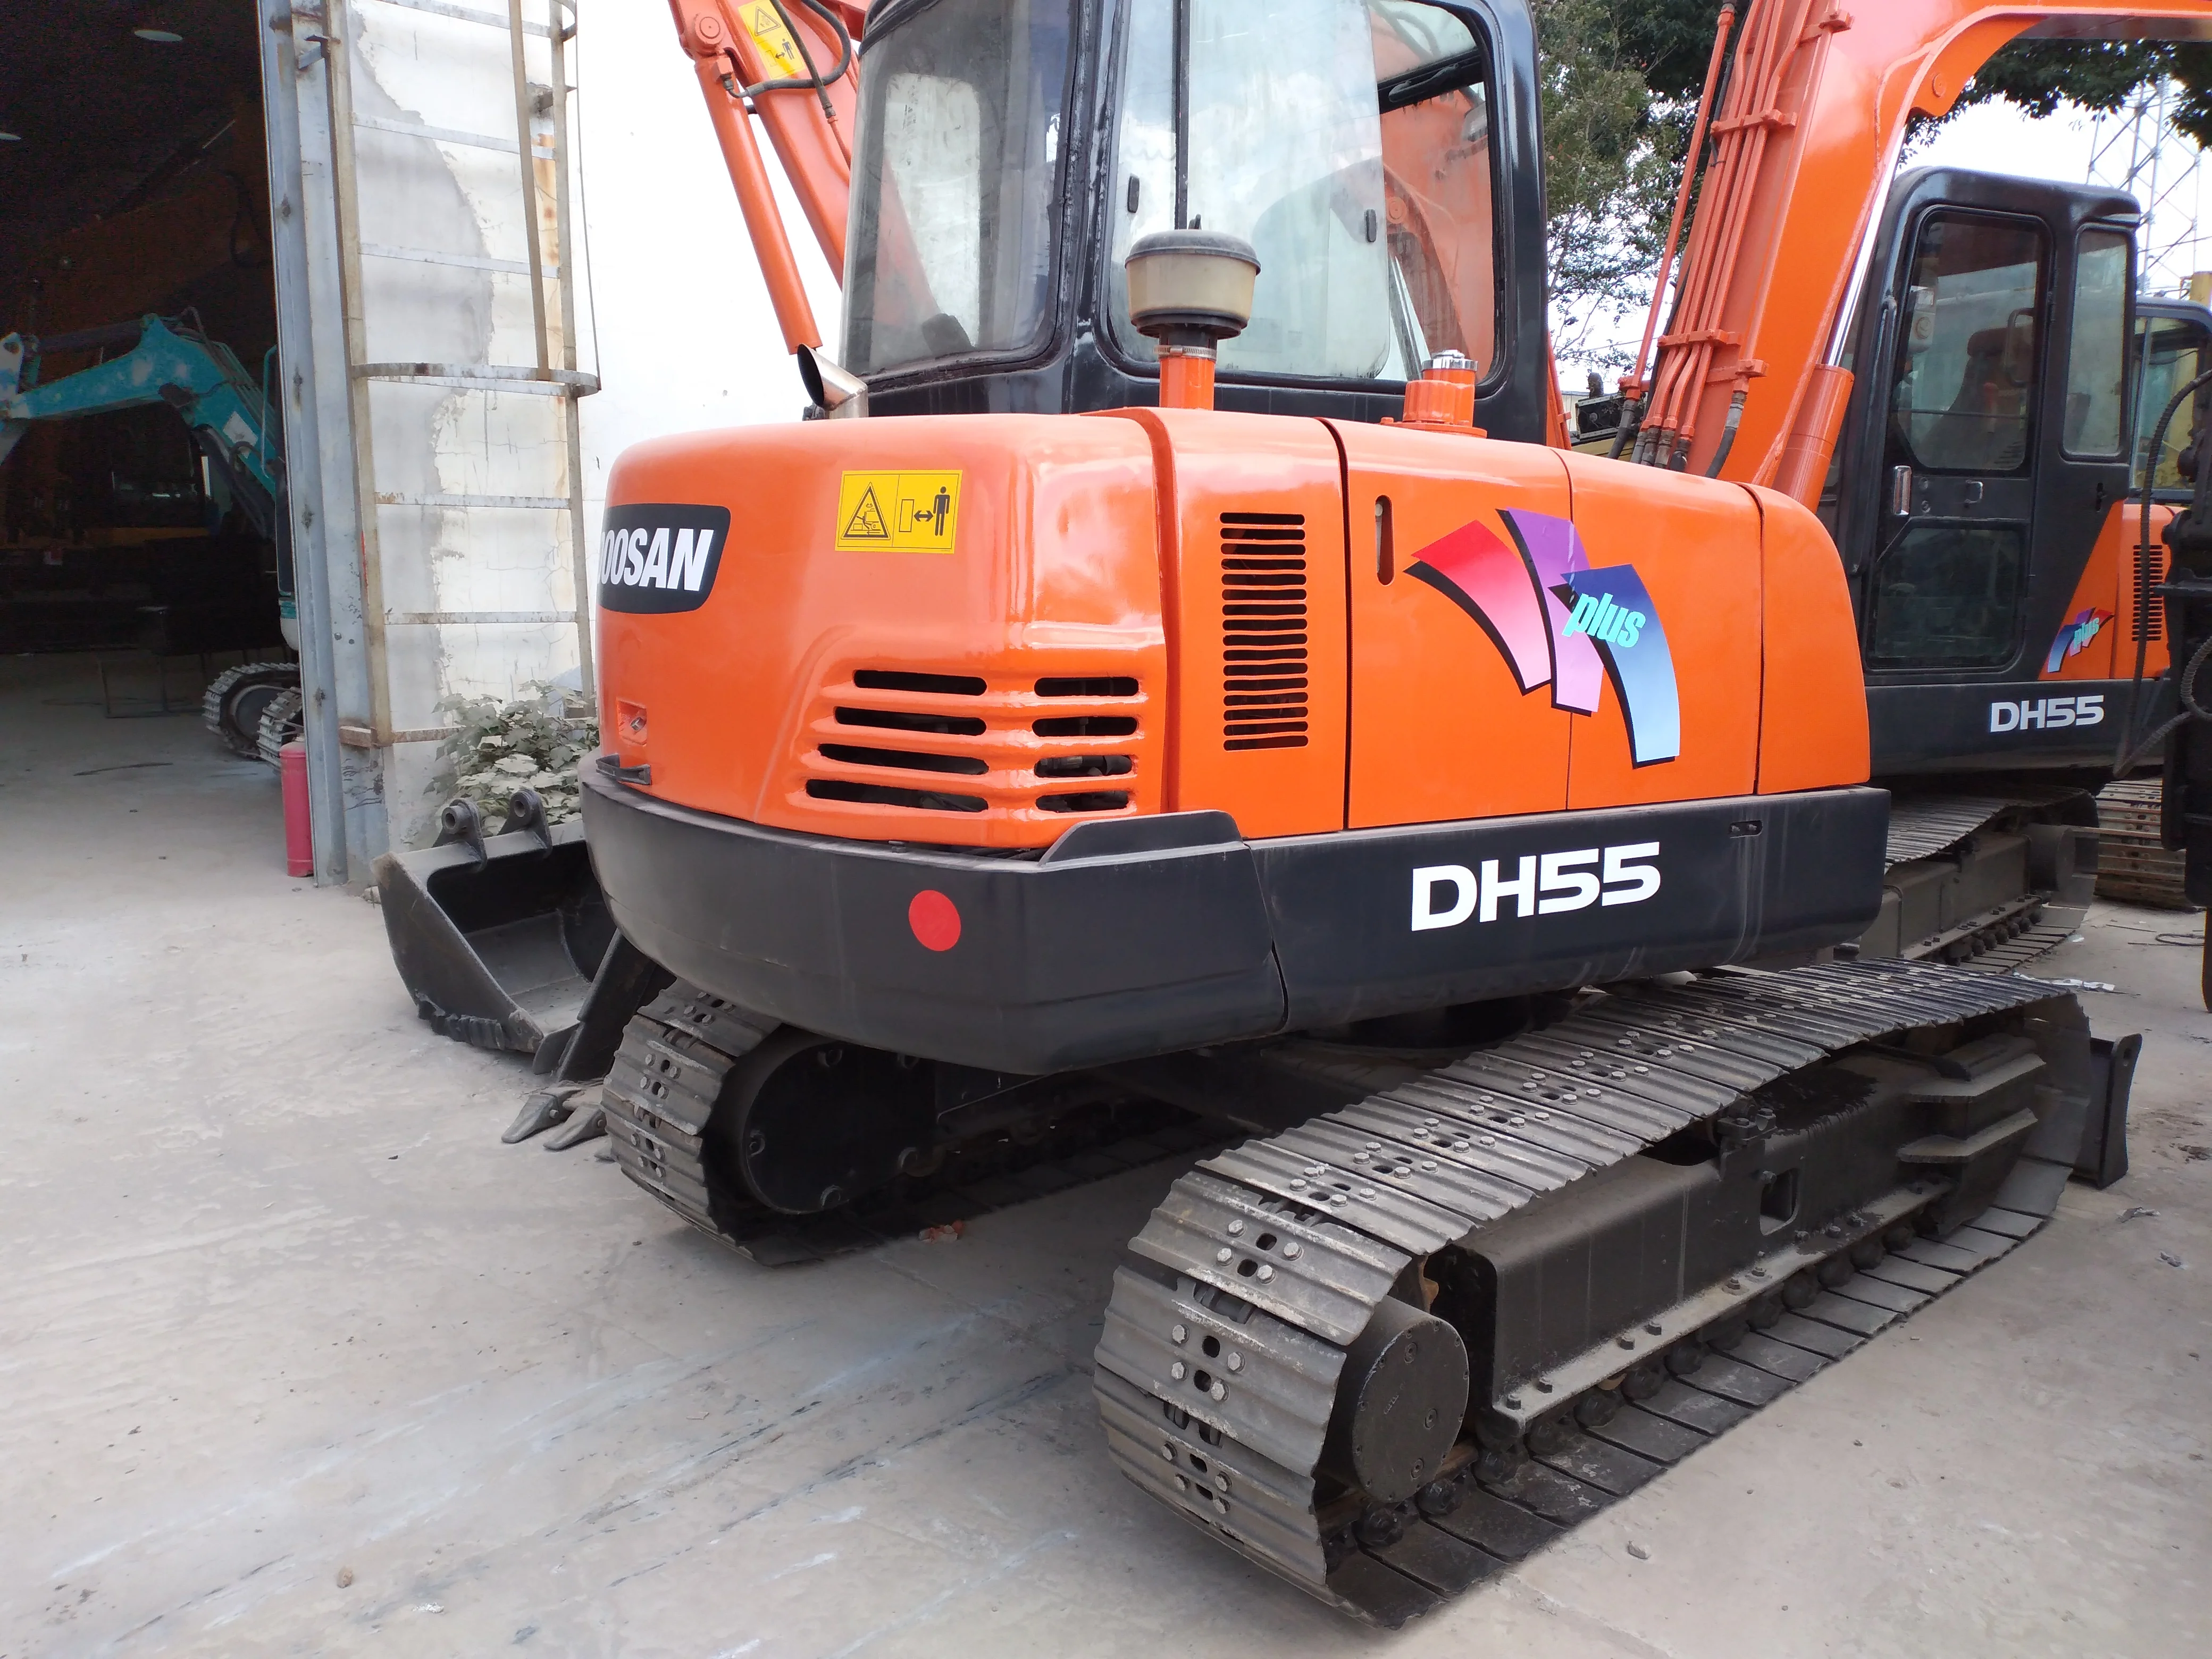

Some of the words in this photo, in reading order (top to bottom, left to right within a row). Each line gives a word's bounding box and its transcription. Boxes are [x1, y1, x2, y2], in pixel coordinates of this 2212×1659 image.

[1562, 592, 1646, 648] plus
[2073, 617, 2100, 649] plus
[1990, 694, 2104, 733] DH55
[1411, 841, 1661, 932] DH55
